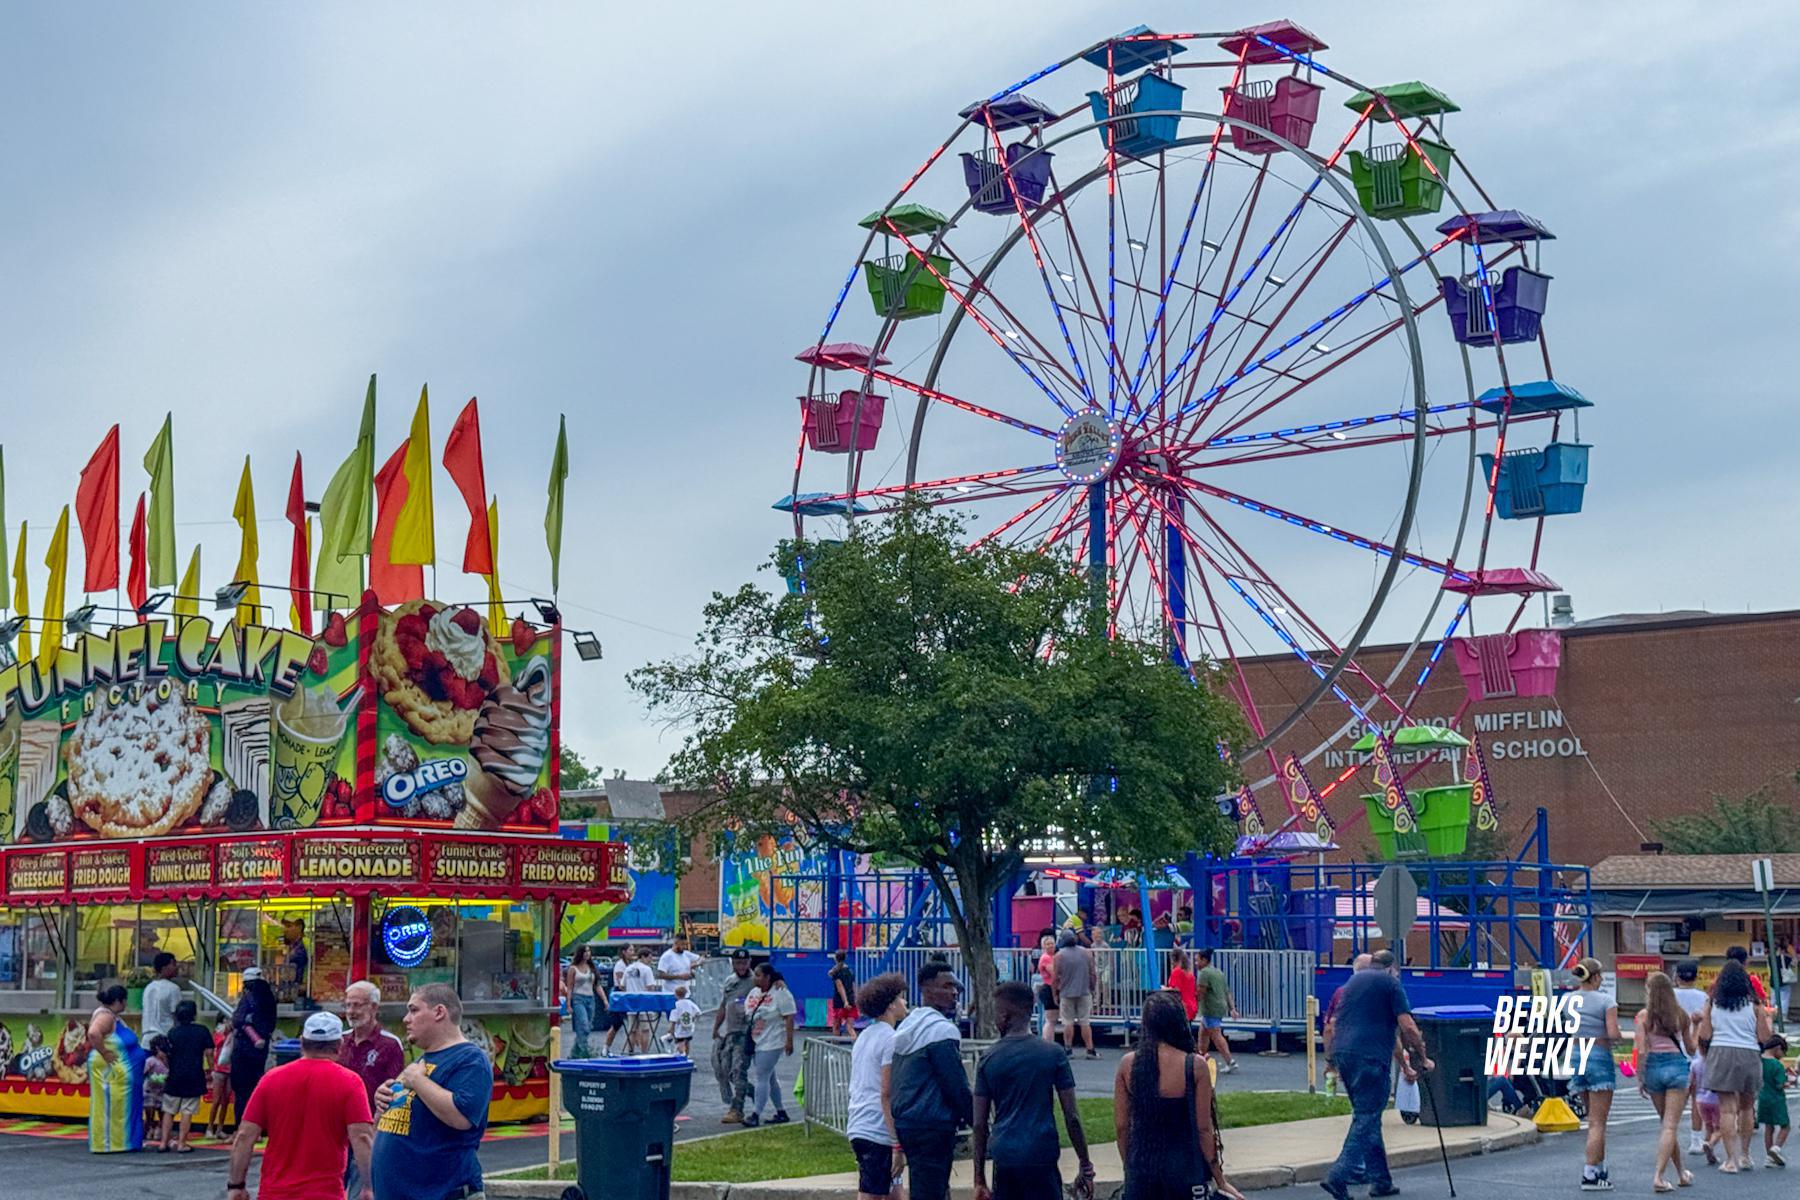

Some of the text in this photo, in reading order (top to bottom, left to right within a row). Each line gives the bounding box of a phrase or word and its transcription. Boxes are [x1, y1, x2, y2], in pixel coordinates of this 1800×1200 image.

[176, 617, 315, 696] CAKE
[61, 678, 227, 720] FACTORY
[1474, 709, 1564, 733] MIFFLIN
[1492, 738, 1588, 760] SCHOOL
[386, 758, 467, 801] OREO
[79, 855, 92, 866] Hot
[102, 853, 126, 865] Sweet
[160, 848, 202, 862] Red Velvet
[305, 843, 407, 859] Fresh Squeezed
[442, 844, 502, 859] Funnel Cake
[538, 850, 581, 863] Delicious
[745, 857, 773, 873] The
[774, 848, 804, 868] Fun
[74, 867, 130, 885] FRIED DOUGH
[151, 863, 211, 881] FUNNEL CAKES
[222, 860, 282, 879] ICE CREAM
[300, 858, 412, 877] LEMONADE
[436, 858, 506, 878] SUNDAES
[522, 863, 595, 882] FRIED OREOS
[12, 870, 64, 888] CHEESECAKE
[390, 923, 426, 940] OREO
[20, 1046, 53, 1071] OREO
